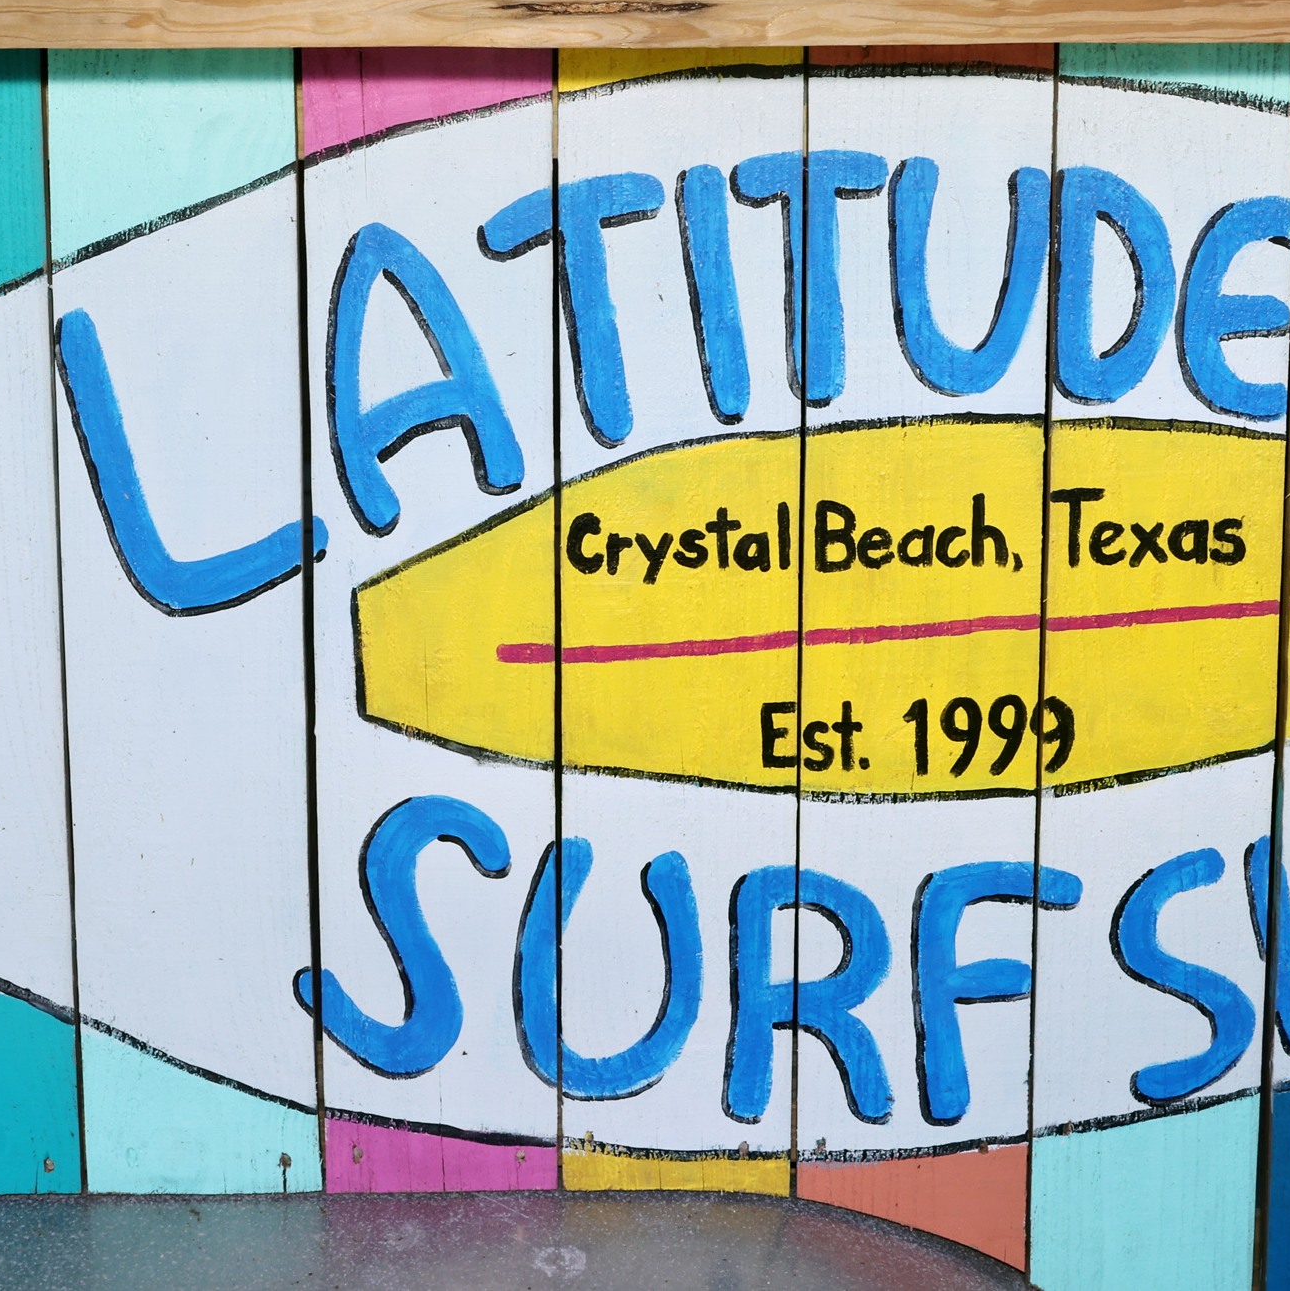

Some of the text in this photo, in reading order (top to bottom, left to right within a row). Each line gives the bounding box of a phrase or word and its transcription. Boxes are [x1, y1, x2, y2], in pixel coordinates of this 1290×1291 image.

[565, 487, 1248, 585] Crystal Beach, Texas
[760, 694, 1076, 777] Est. 1999
[294, 794, 1084, 1125] SURF
